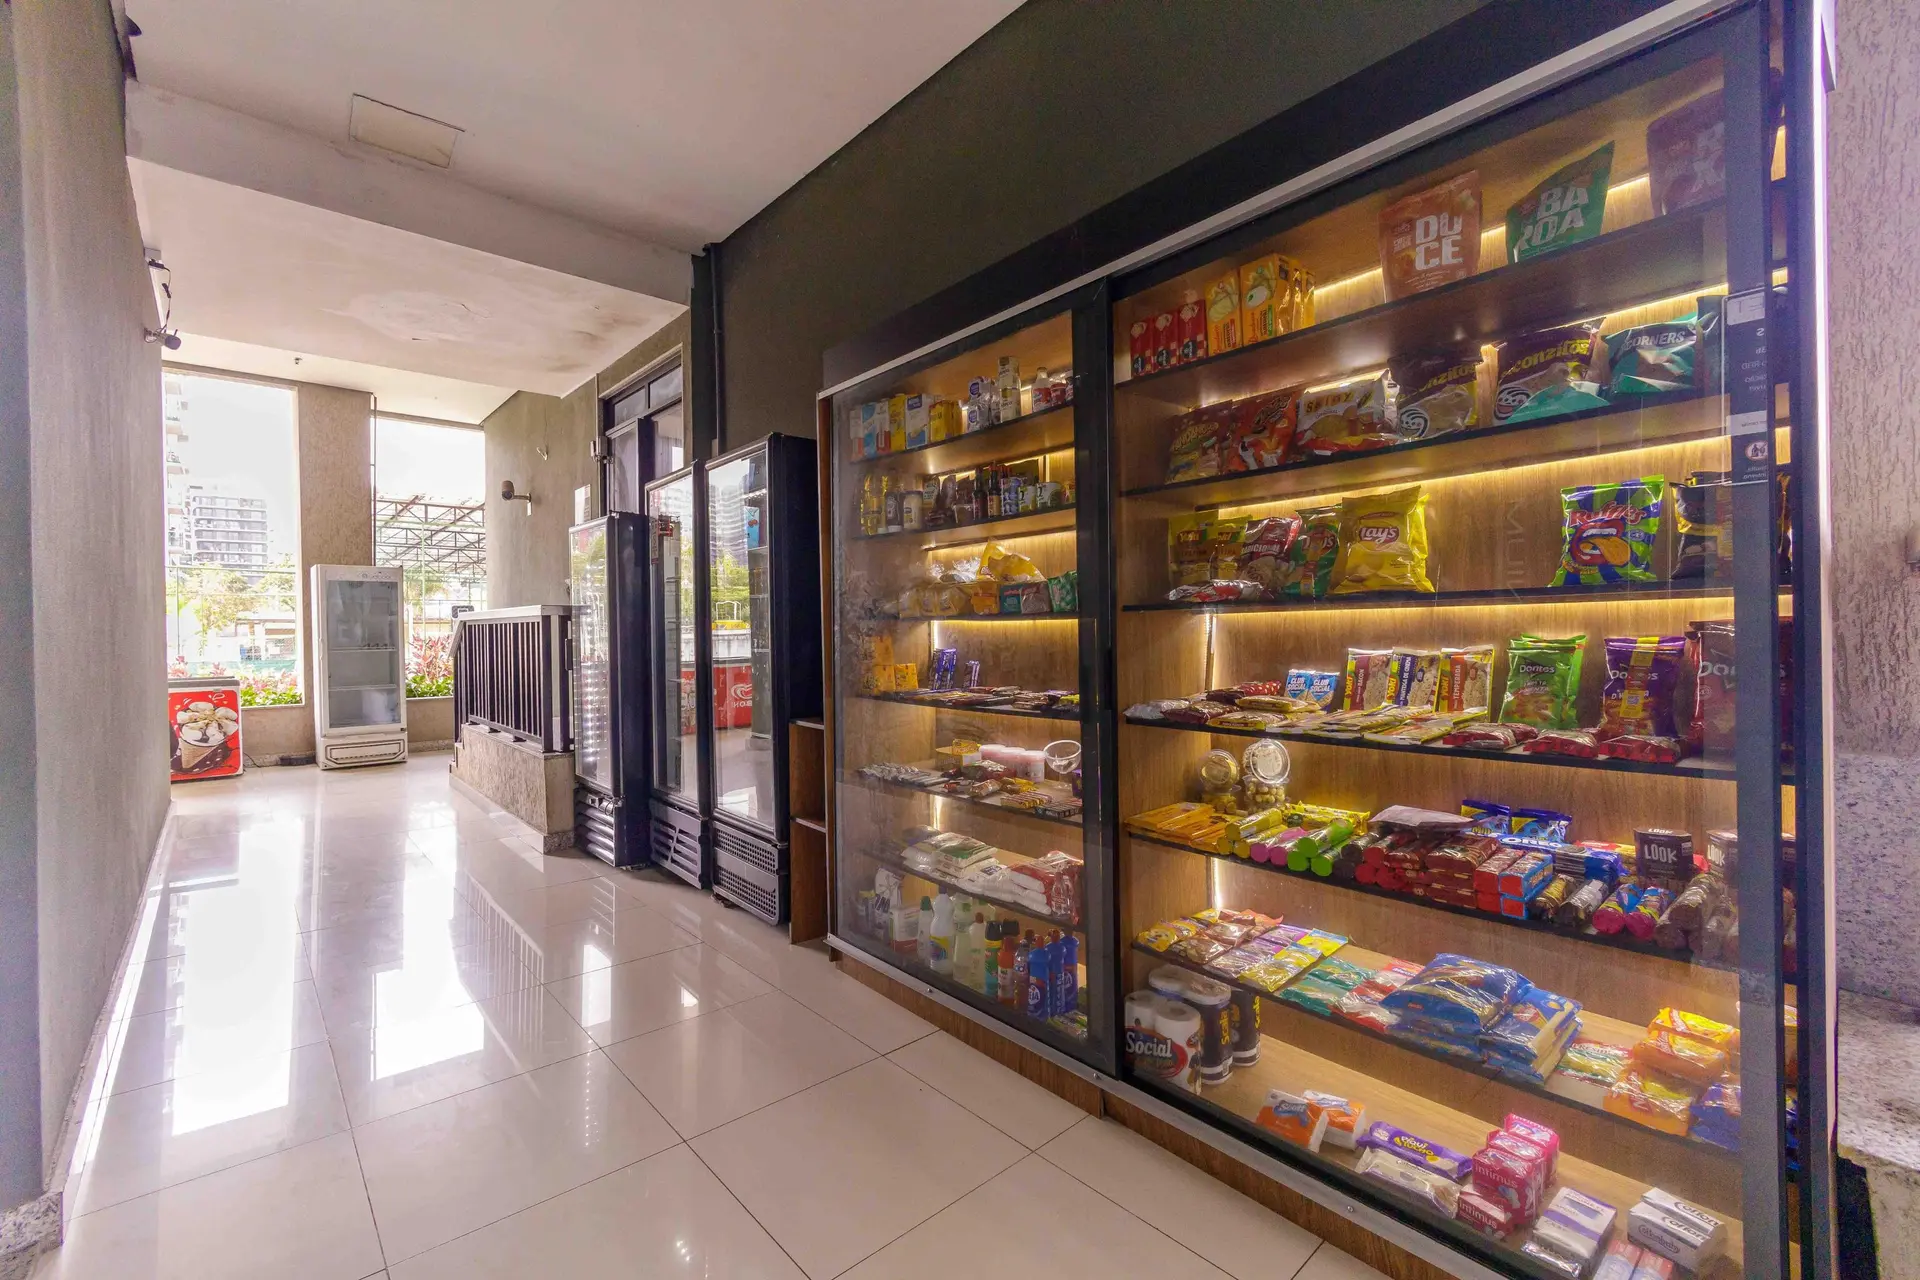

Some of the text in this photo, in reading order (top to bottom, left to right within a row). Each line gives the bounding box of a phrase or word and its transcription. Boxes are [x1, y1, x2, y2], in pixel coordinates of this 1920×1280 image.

[1415, 234, 1463, 270] CE
[1569, 501, 1647, 527] Ruffles
[1361, 527, 1398, 545] Lay's
[1519, 664, 1556, 674] Doritos
[1644, 843, 1677, 864] LOOK
